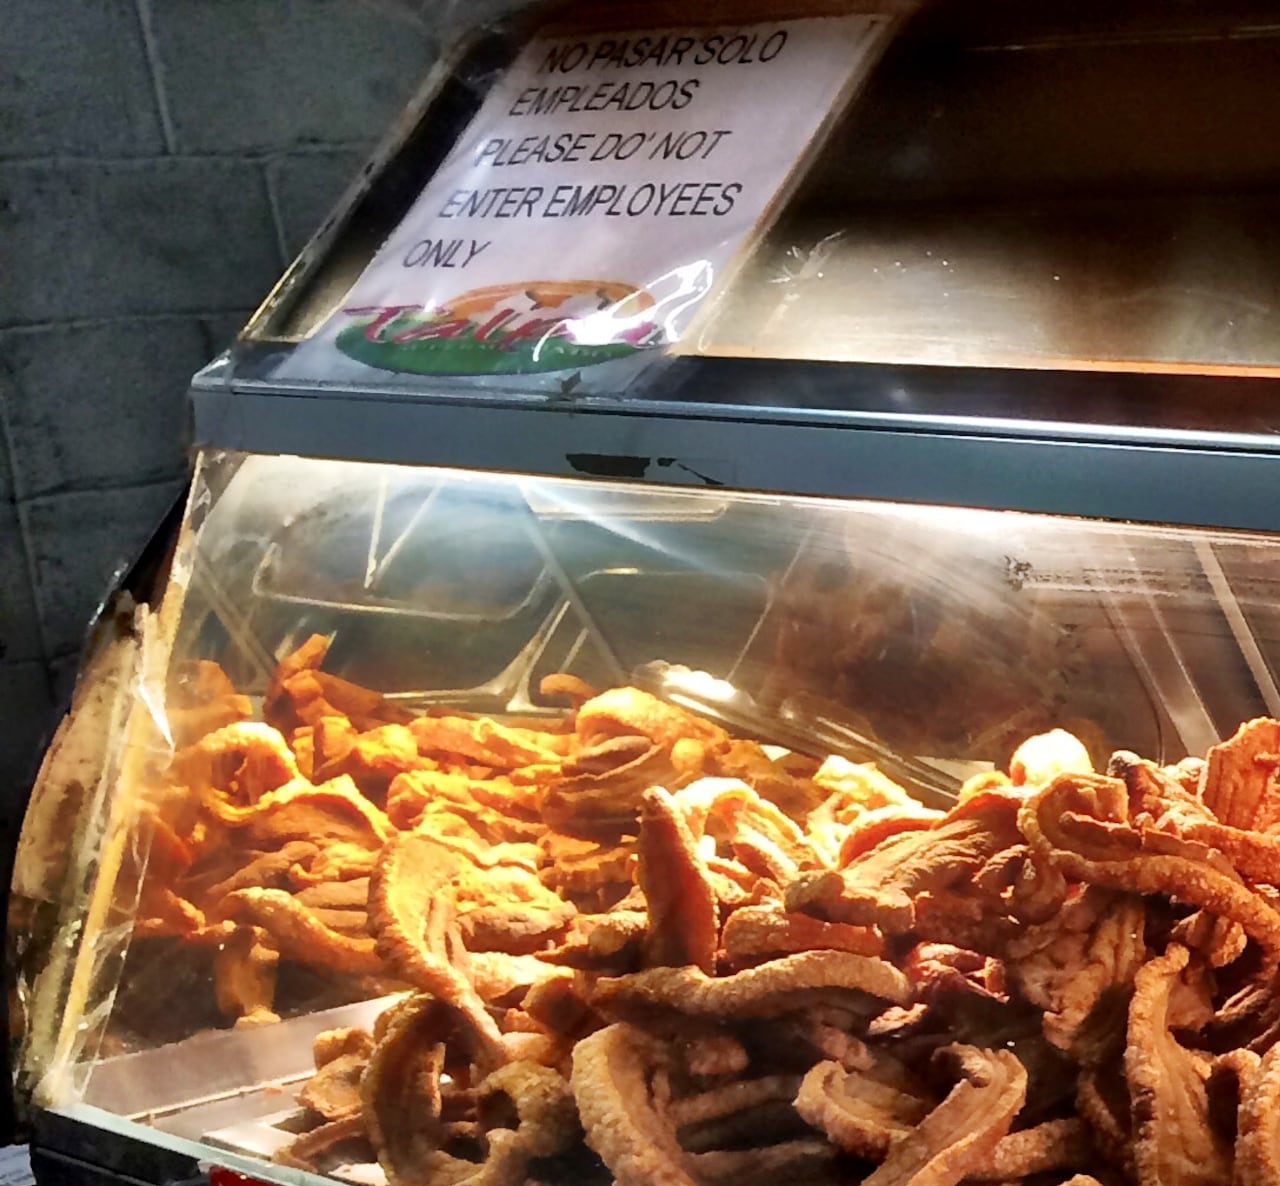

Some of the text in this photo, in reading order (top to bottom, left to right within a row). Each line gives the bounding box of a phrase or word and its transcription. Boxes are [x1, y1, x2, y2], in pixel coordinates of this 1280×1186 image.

[538, 30, 788, 73] NO PASAR SOLO
[509, 79, 701, 116] EMPLEADOS
[475, 133, 595, 167] PLEASE
[438, 183, 743, 218] ENTER EMPLOYEES
[402, 239, 492, 268] ONLY
